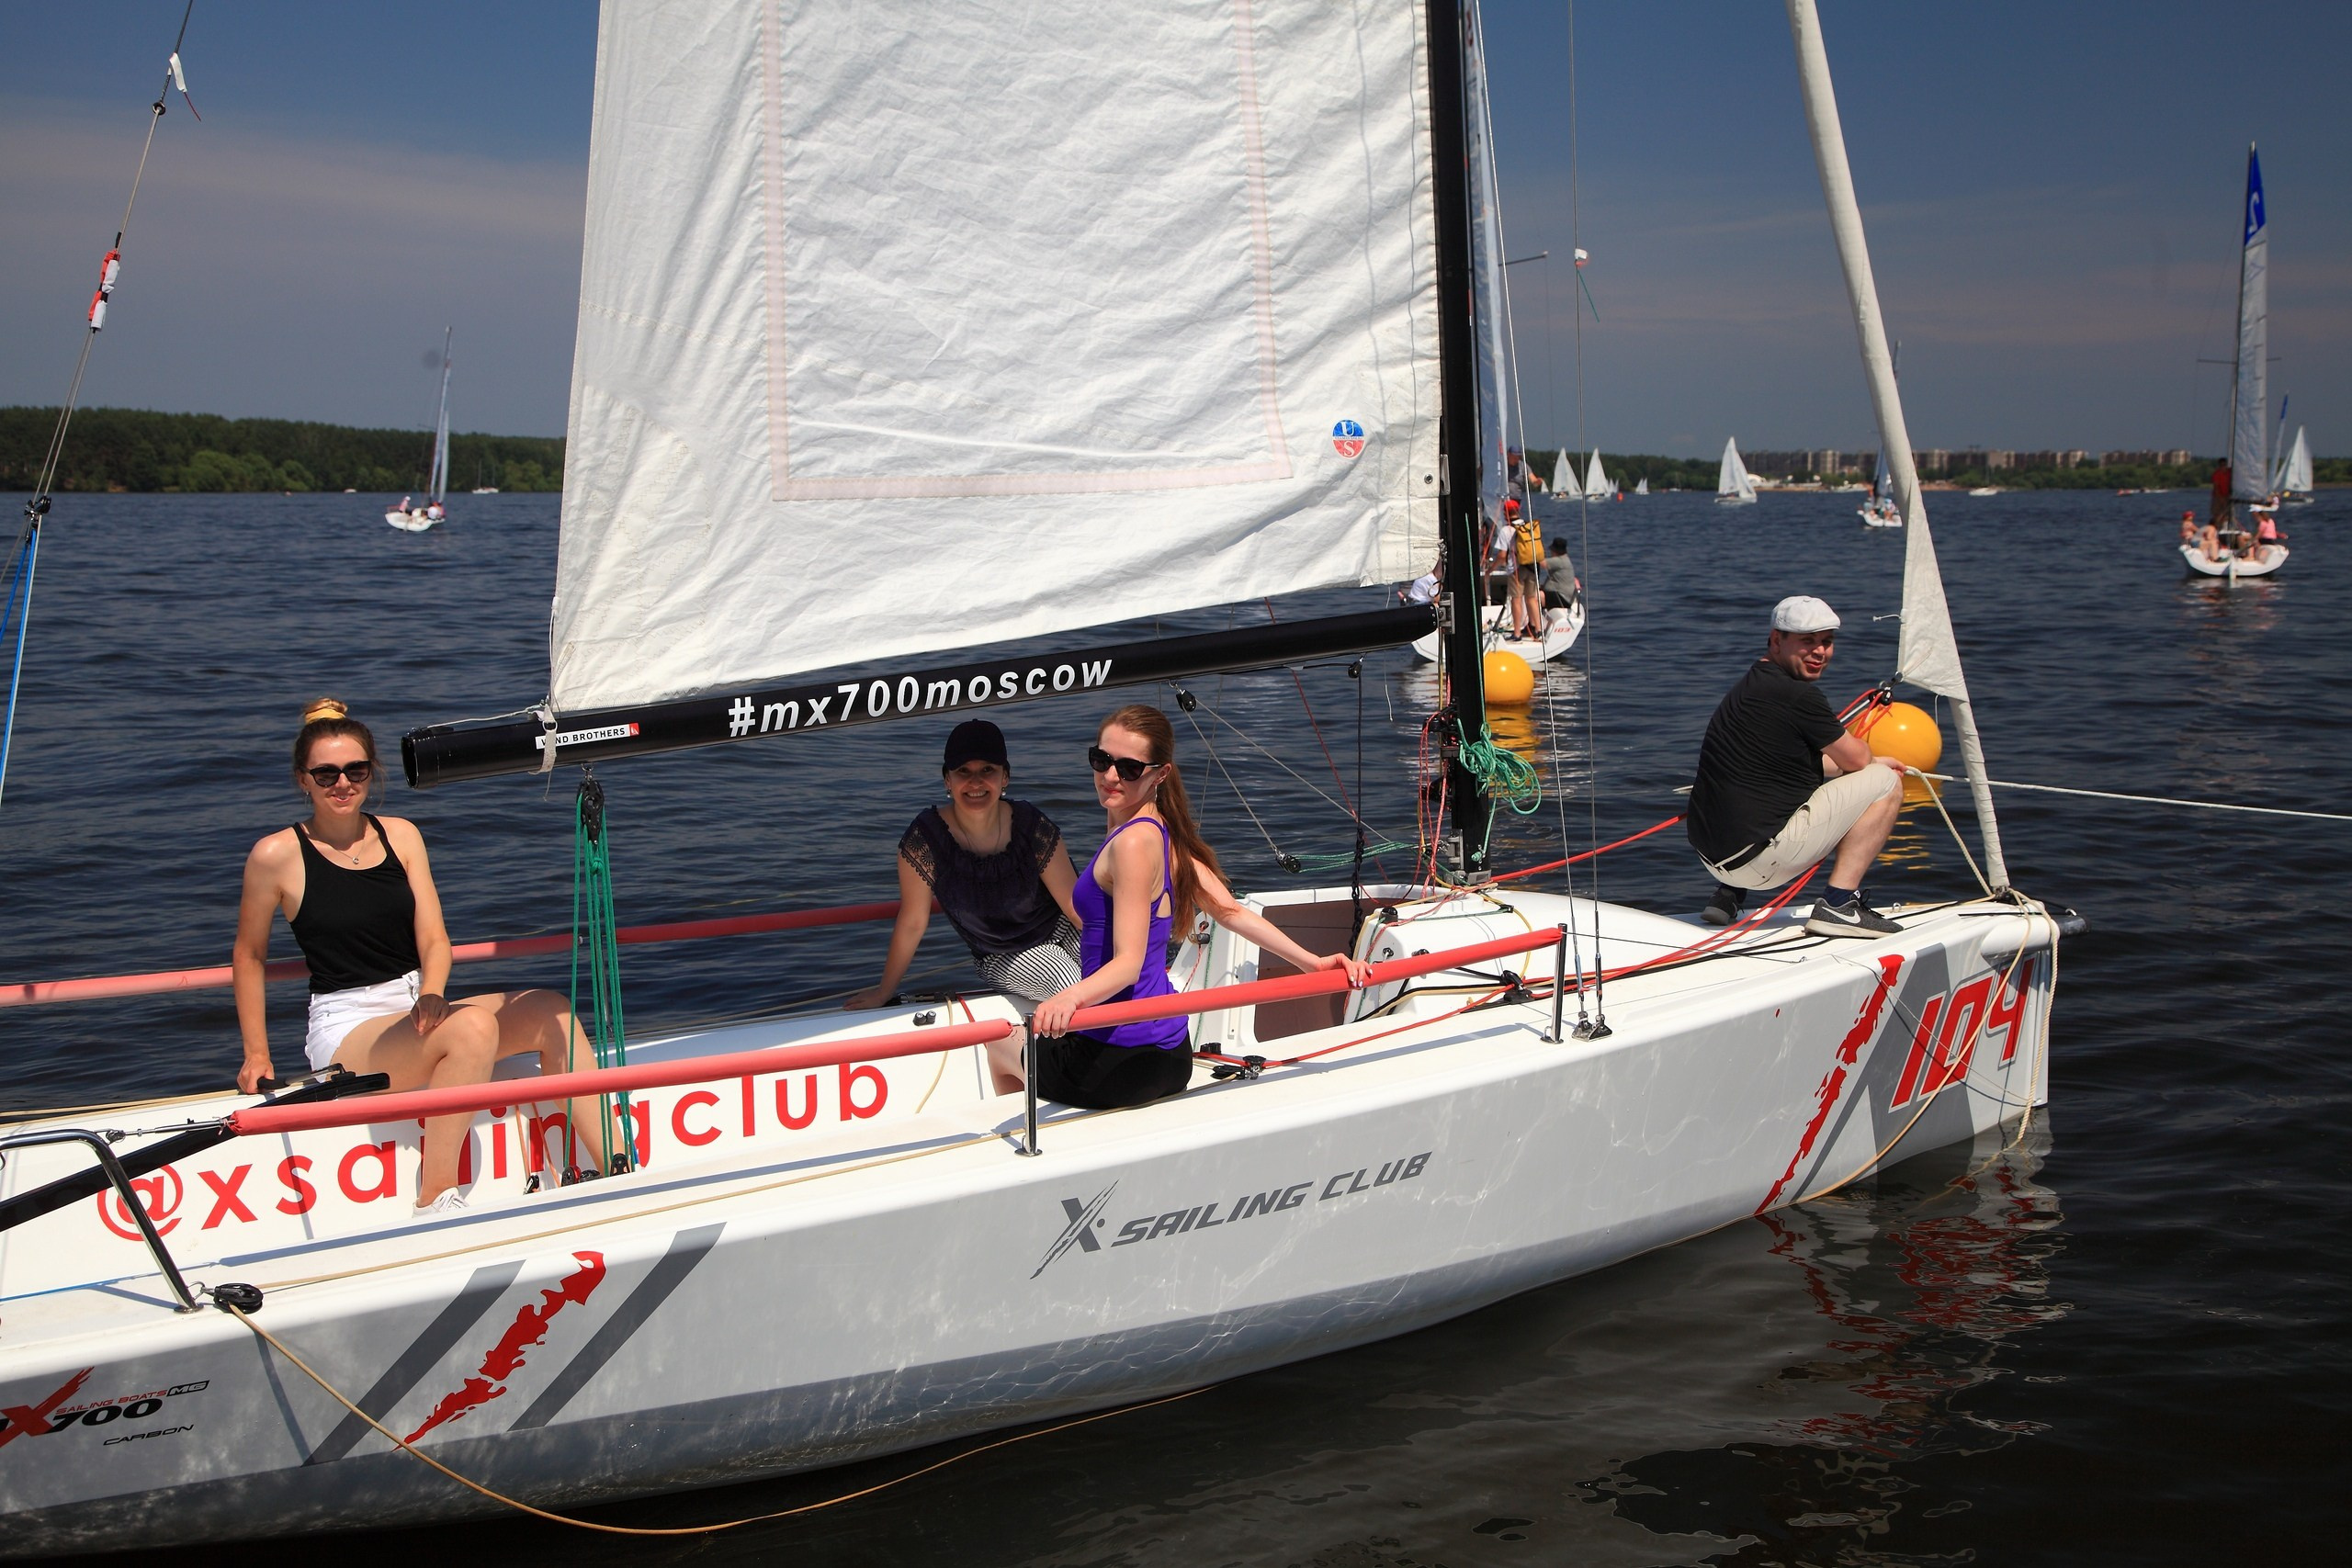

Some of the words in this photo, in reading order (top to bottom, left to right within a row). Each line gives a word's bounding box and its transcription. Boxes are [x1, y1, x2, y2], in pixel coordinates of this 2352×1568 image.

[540, 735, 569, 746] ND
[571, 727, 627, 742] BROTHERS
[727, 658, 1114, 738] #mx700moscow
[1889, 956, 2038, 1110] 104
[96, 1062, 888, 1241] @xsainclub
[1110, 1180, 1314, 1248] SAILING
[1318, 1150, 1433, 1201] CLUB
[0, 1367, 164, 1449] X700
[55, 1399, 114, 1416] SAILING
[117, 1389, 168, 1404] BOATS
[102, 1424, 195, 1447] CARBON
